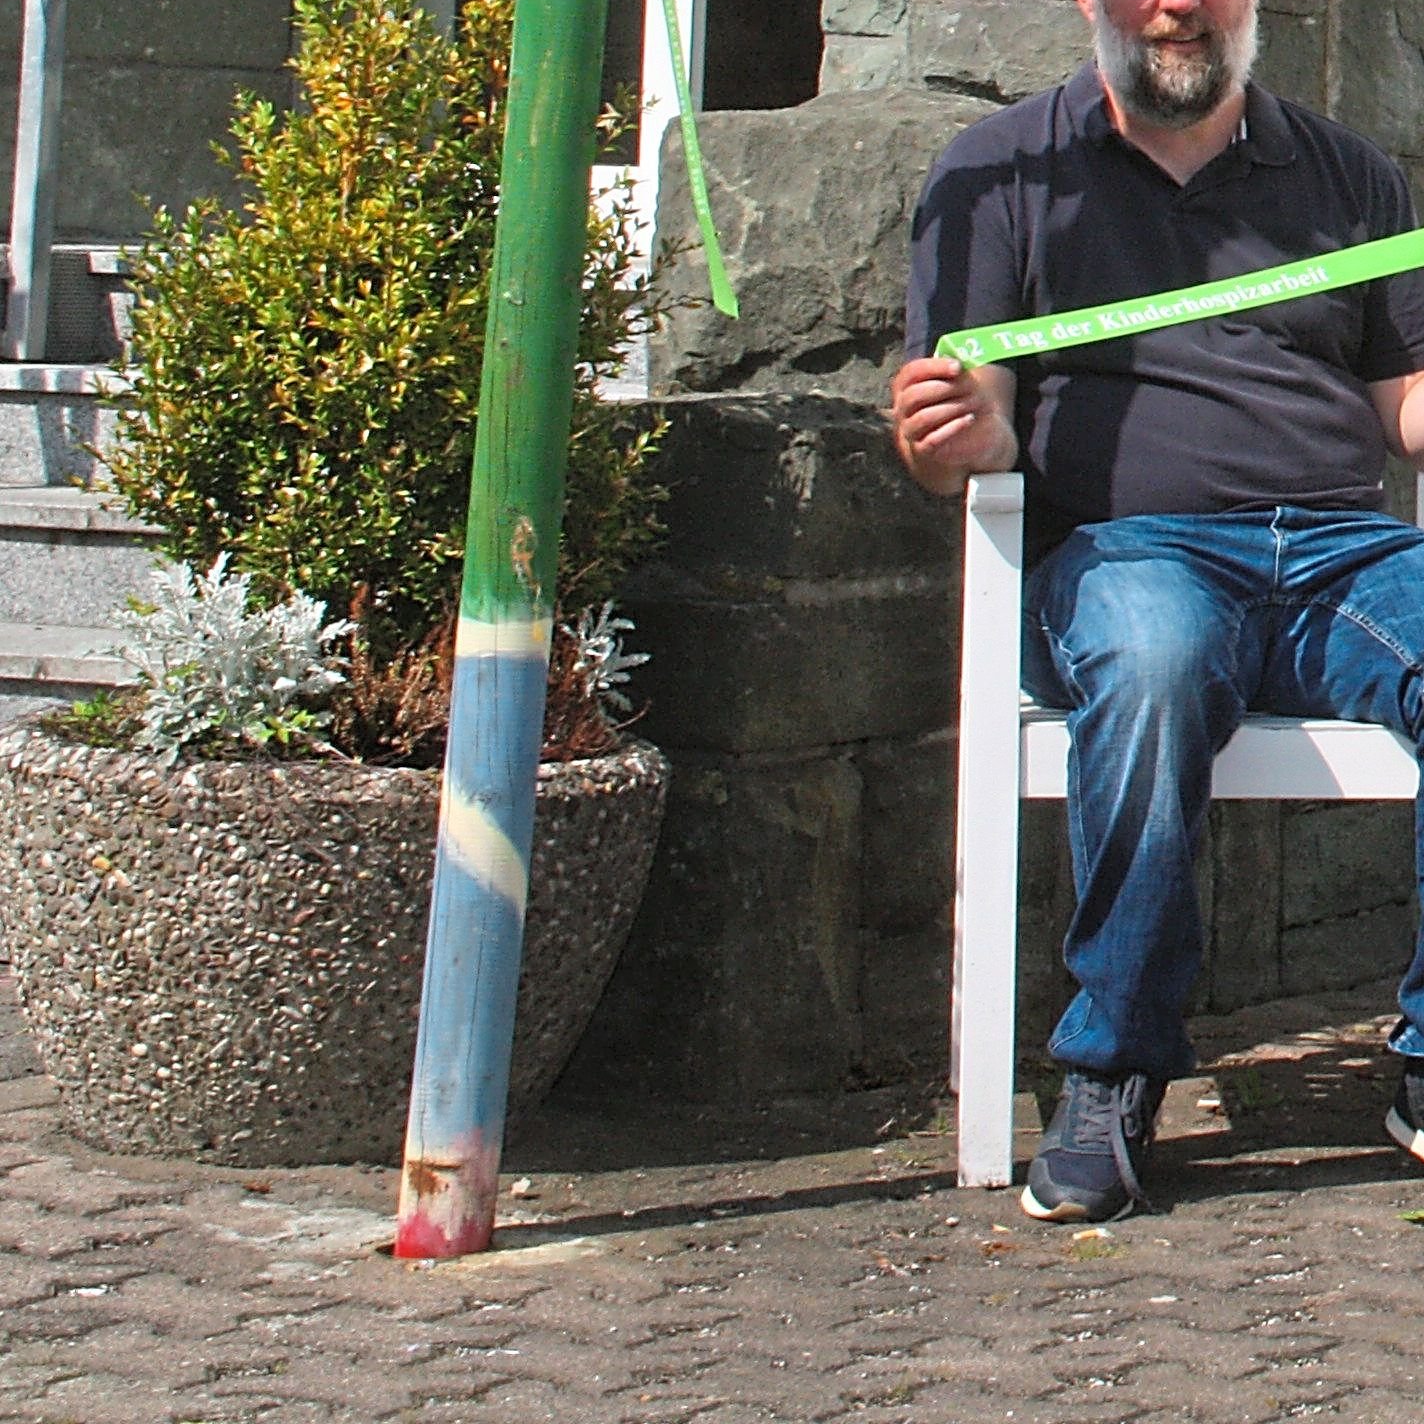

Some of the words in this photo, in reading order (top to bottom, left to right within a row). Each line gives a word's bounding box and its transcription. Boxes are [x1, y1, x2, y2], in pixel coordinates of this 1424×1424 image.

[993, 329, 1049, 350] Tag
[1051, 321, 1093, 341] der
[1098, 266, 1330, 332] Kinderhospizarbeit
